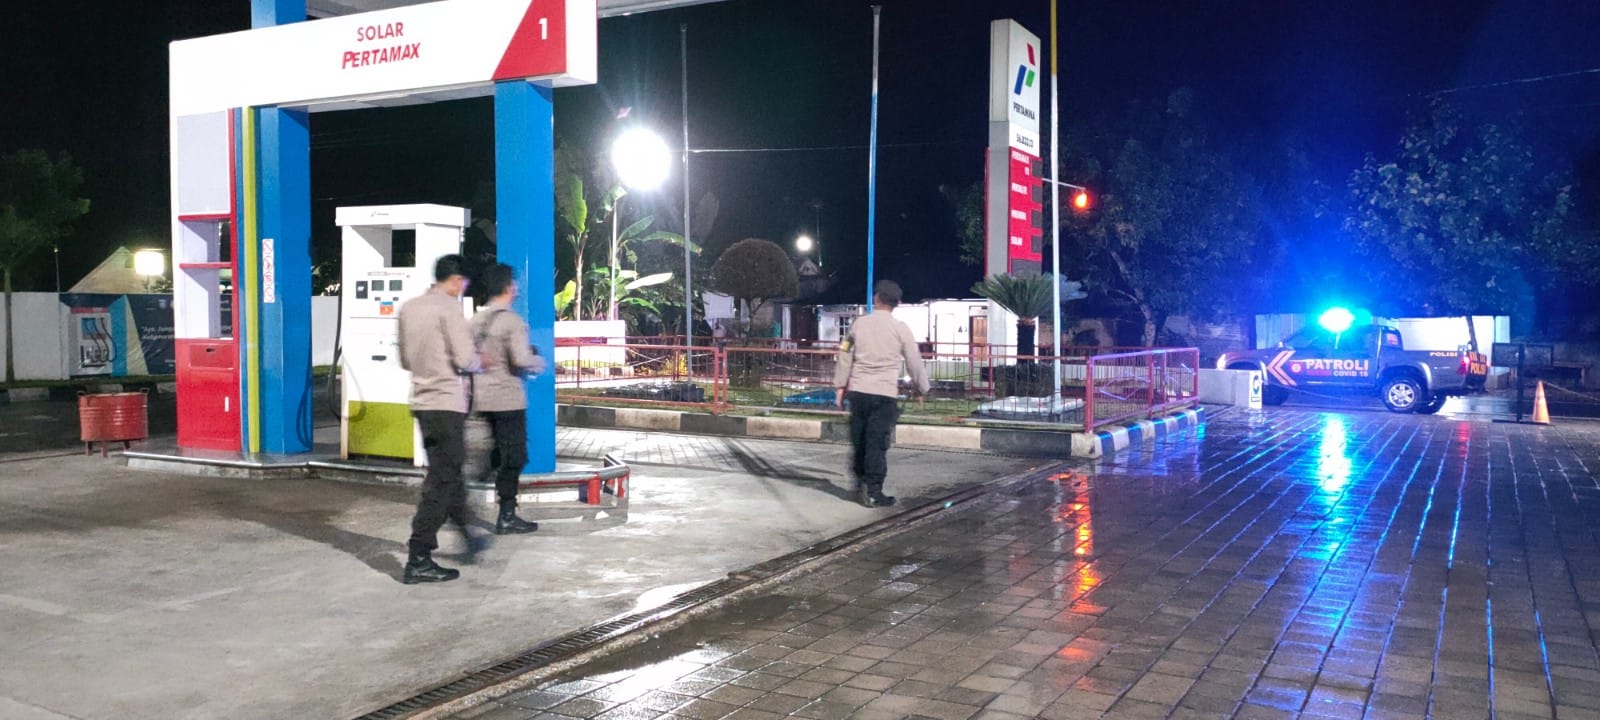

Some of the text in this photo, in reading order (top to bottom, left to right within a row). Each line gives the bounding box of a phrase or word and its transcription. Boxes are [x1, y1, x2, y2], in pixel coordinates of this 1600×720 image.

[357, 22, 404, 42] SOLAR
[538, 18, 549, 40] 1
[341, 43, 421, 69] PERTAMAX
[1305, 359, 1369, 371] PATROLI
